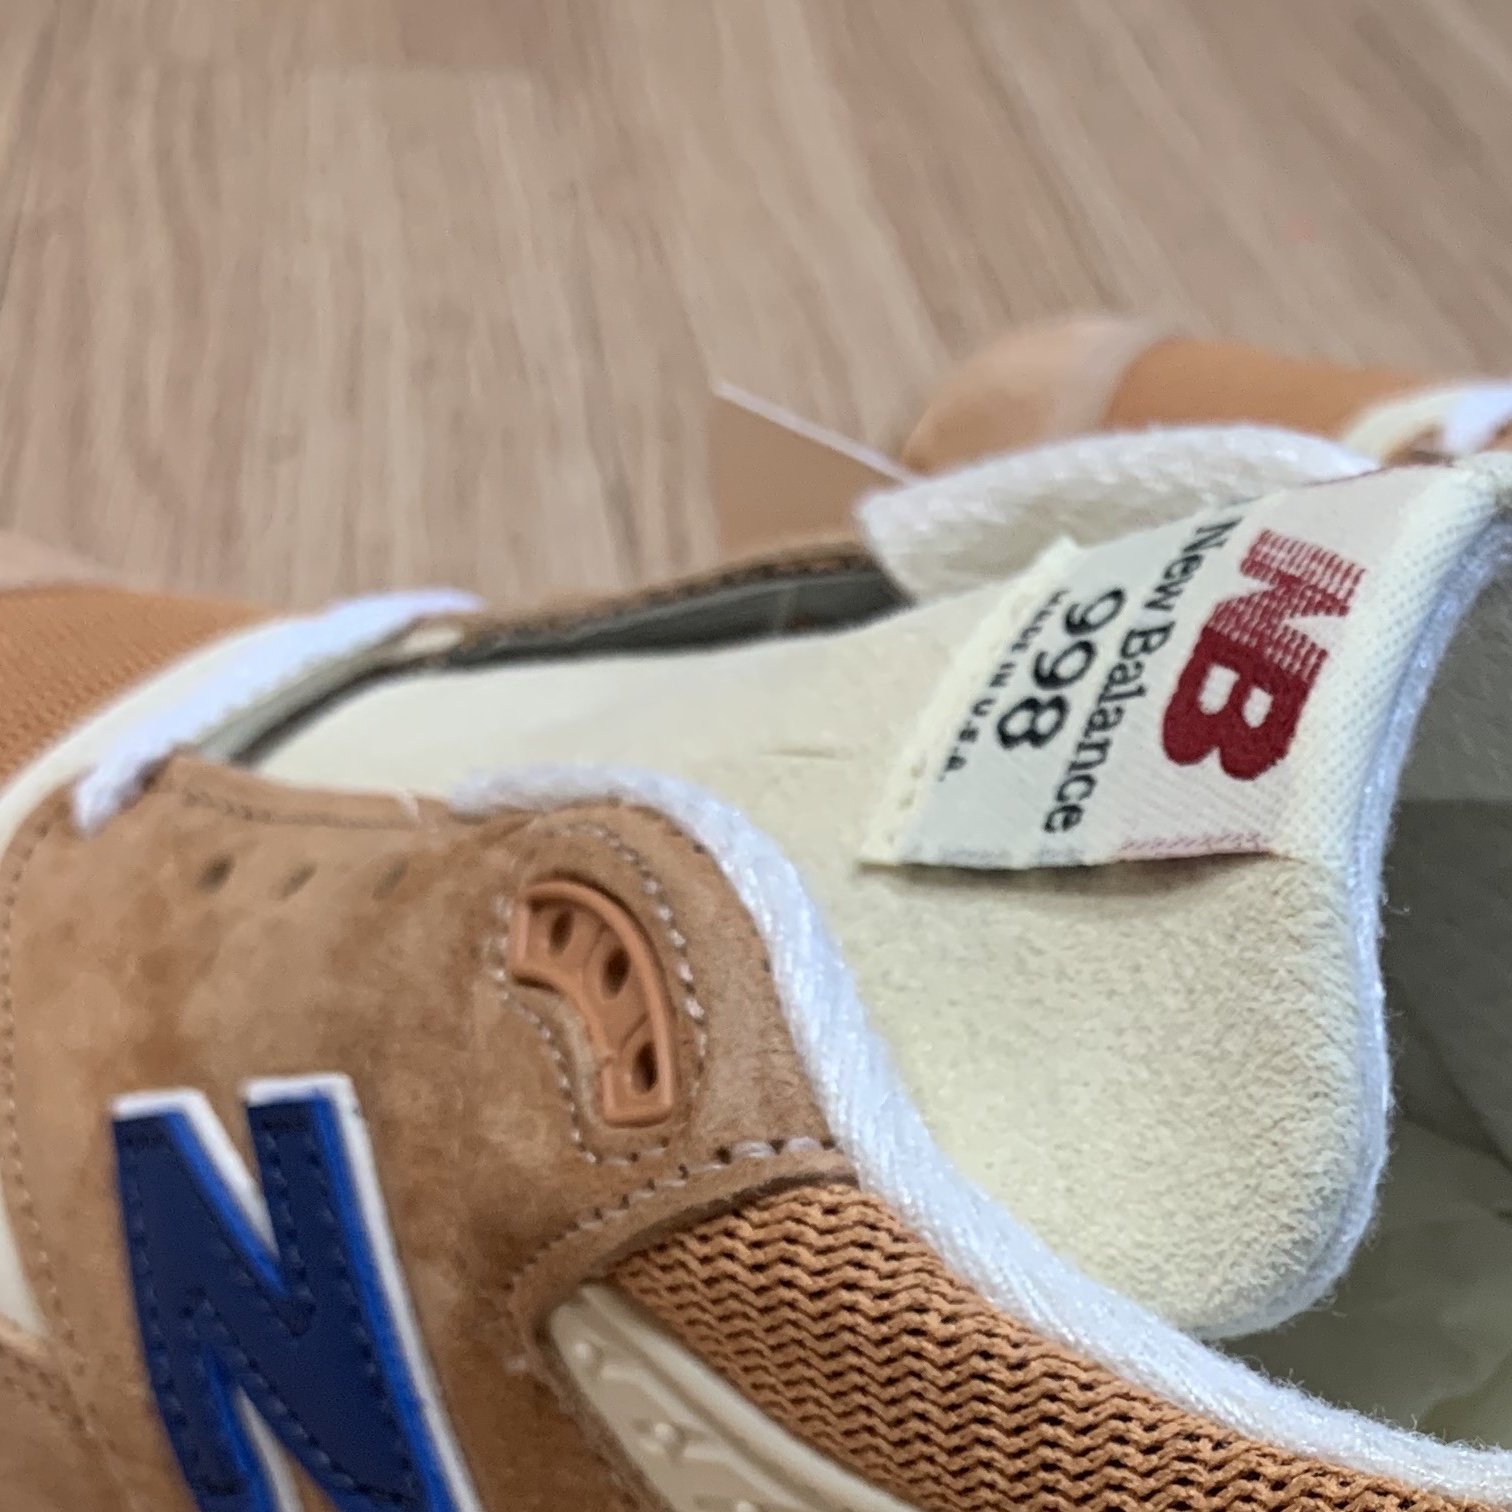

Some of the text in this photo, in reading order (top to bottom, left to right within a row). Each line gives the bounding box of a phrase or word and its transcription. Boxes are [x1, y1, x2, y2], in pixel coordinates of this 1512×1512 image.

[996, 587, 1126, 752] 998
[1043, 515, 1243, 834] New Balance
[1162, 527, 1367, 780] NB
